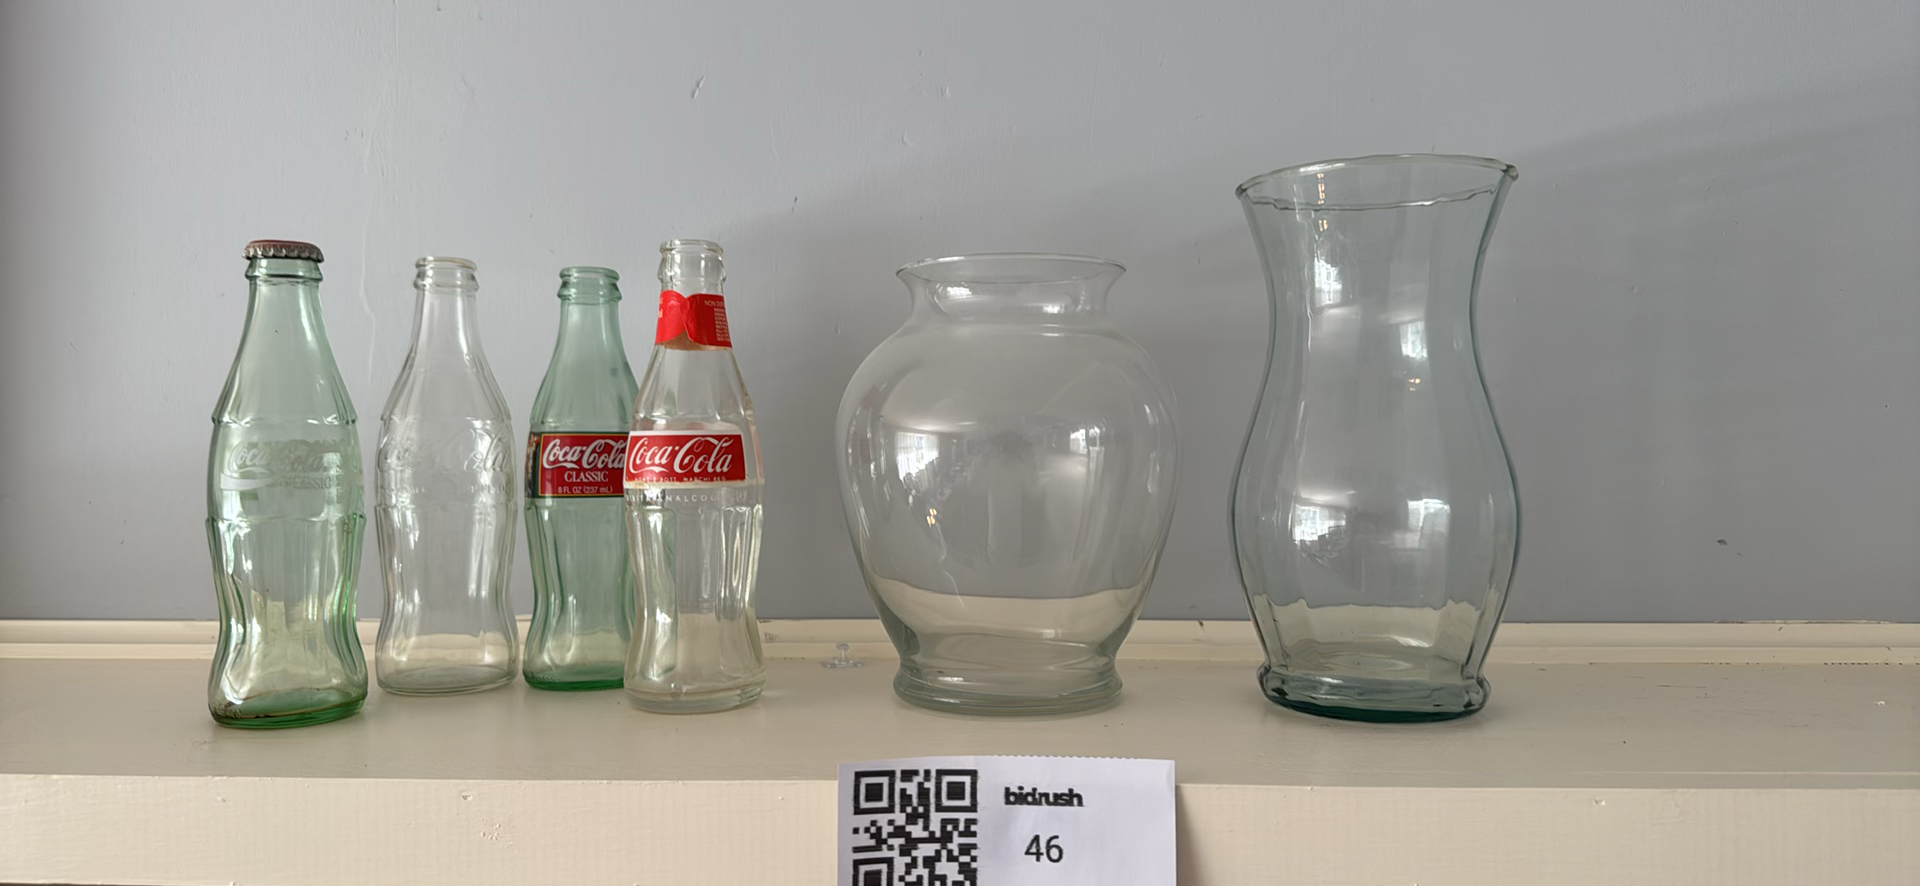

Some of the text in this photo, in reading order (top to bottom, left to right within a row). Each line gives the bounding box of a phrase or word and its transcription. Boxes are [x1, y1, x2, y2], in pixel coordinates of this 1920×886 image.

[542, 438, 628, 469] Coca-Cola
[629, 437, 734, 474] Coca-Cola
[564, 470, 609, 482] CLASSIC
[557, 486, 562, 494] 8
[572, 486, 582, 494] OZ
[583, 485, 598, 495] (237
[599, 485, 613, 494] mL)
[1004, 785, 1084, 807] bidrush
[1024, 833, 1064, 863] 46
